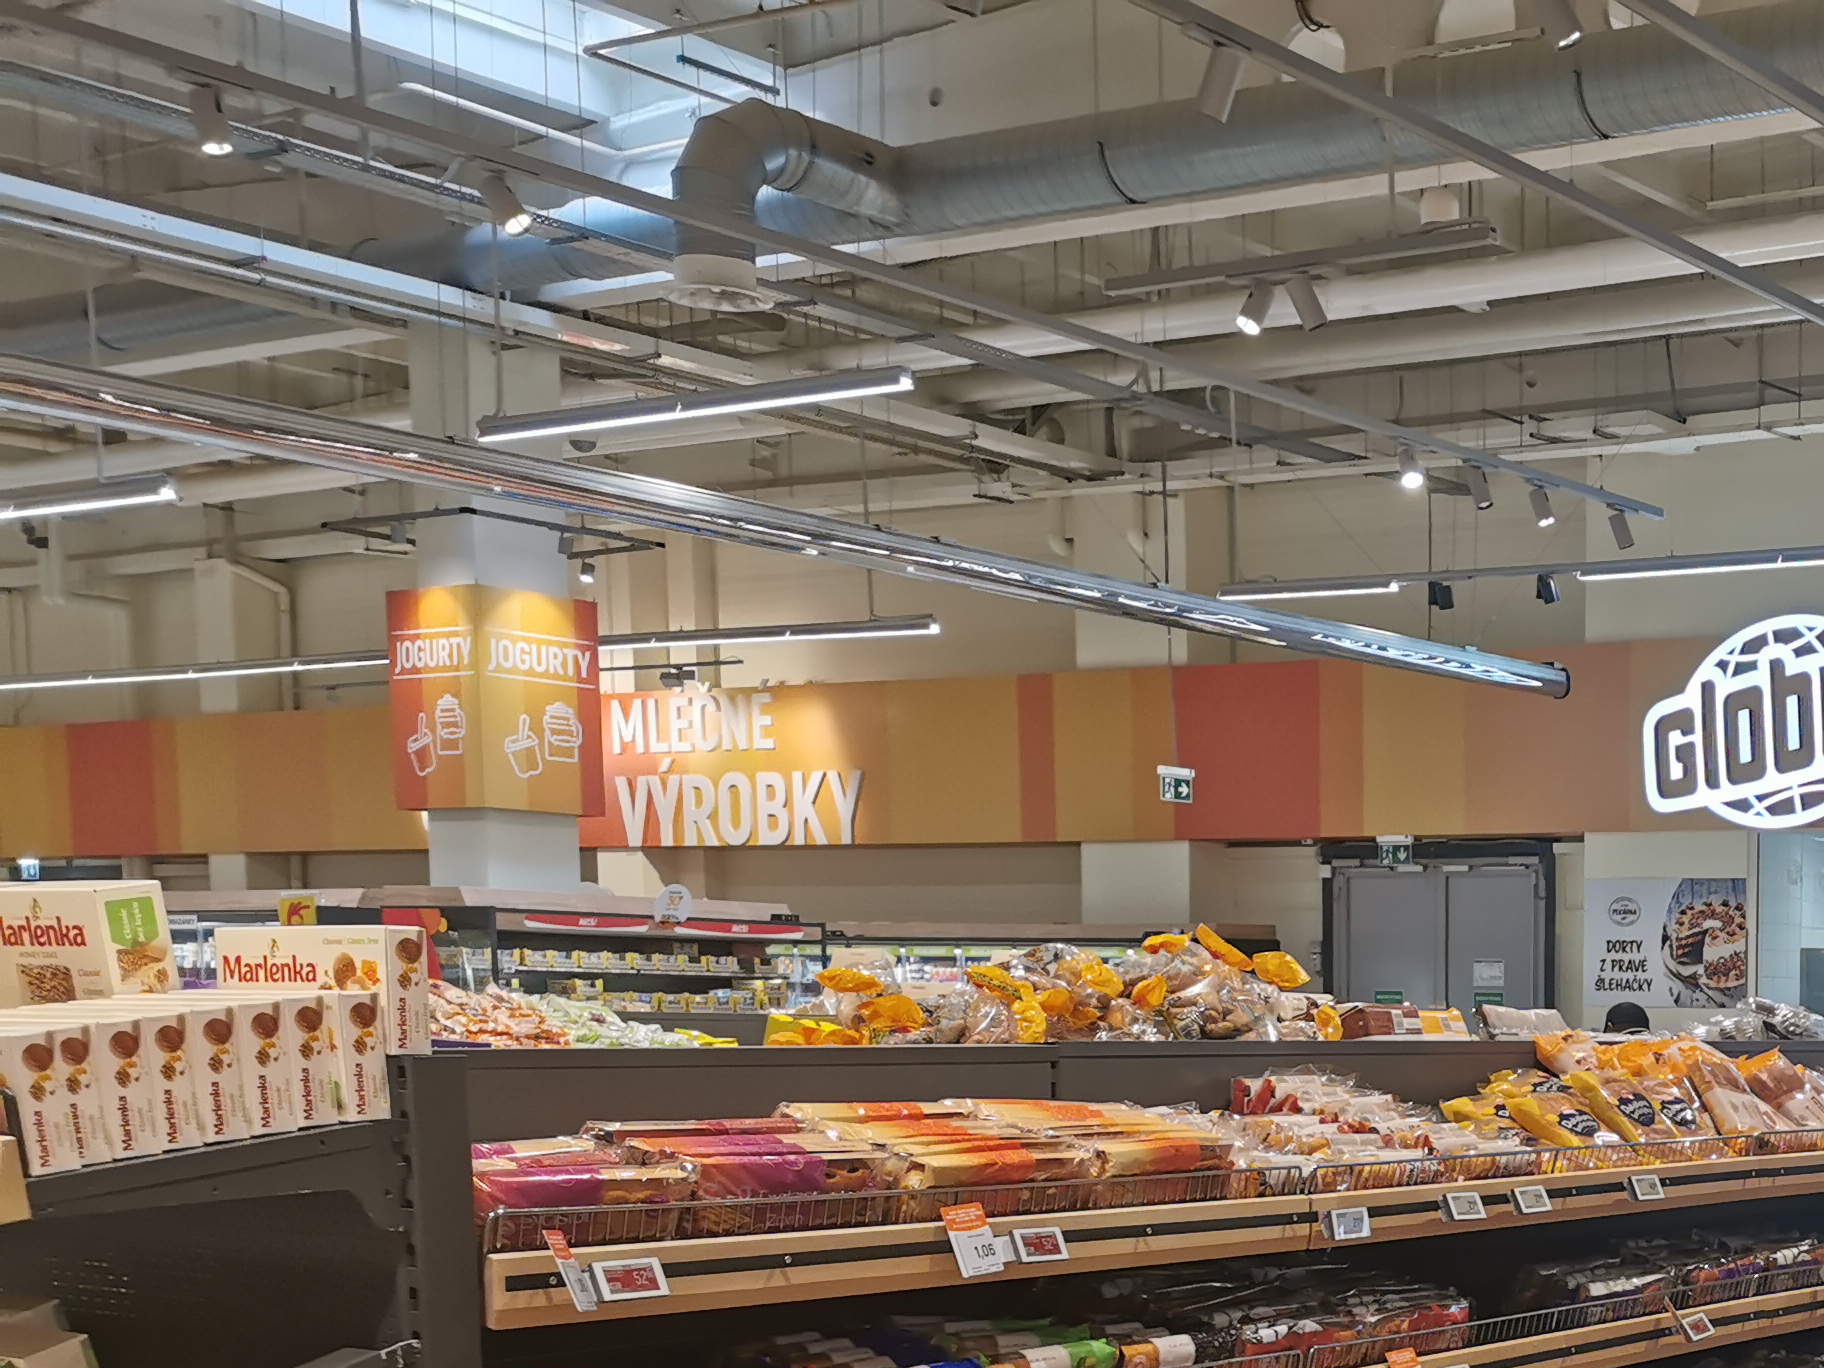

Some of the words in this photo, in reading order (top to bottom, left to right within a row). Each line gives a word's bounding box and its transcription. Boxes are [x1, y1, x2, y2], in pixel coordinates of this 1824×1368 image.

[394, 636, 472, 675] JOGURTY
[487, 637, 592, 679] JOGURTY
[610, 678, 776, 755] MLÉČNÉ
[615, 758, 863, 848] VÝROBKY
[222, 955, 317, 983] Marlenka
[1600, 959, 1607, 972] Z
[1611, 956, 1648, 973] PRAVÉ
[1606, 940, 1643, 954] DORTY
[1595, 975, 1653, 992] ŠLEHAČKY
[398, 997, 408, 1049] Marlenka
[209, 1081, 226, 1136] Marlenka
[257, 1075, 273, 1128] Marlenka
[299, 1068, 315, 1120] Marlenka
[353, 1062, 368, 1115] Marlenka
[33, 1110, 52, 1168] Marlenka
[117, 1095, 135, 1151] Marlenka
[162, 1089, 180, 1144] Marlenka
